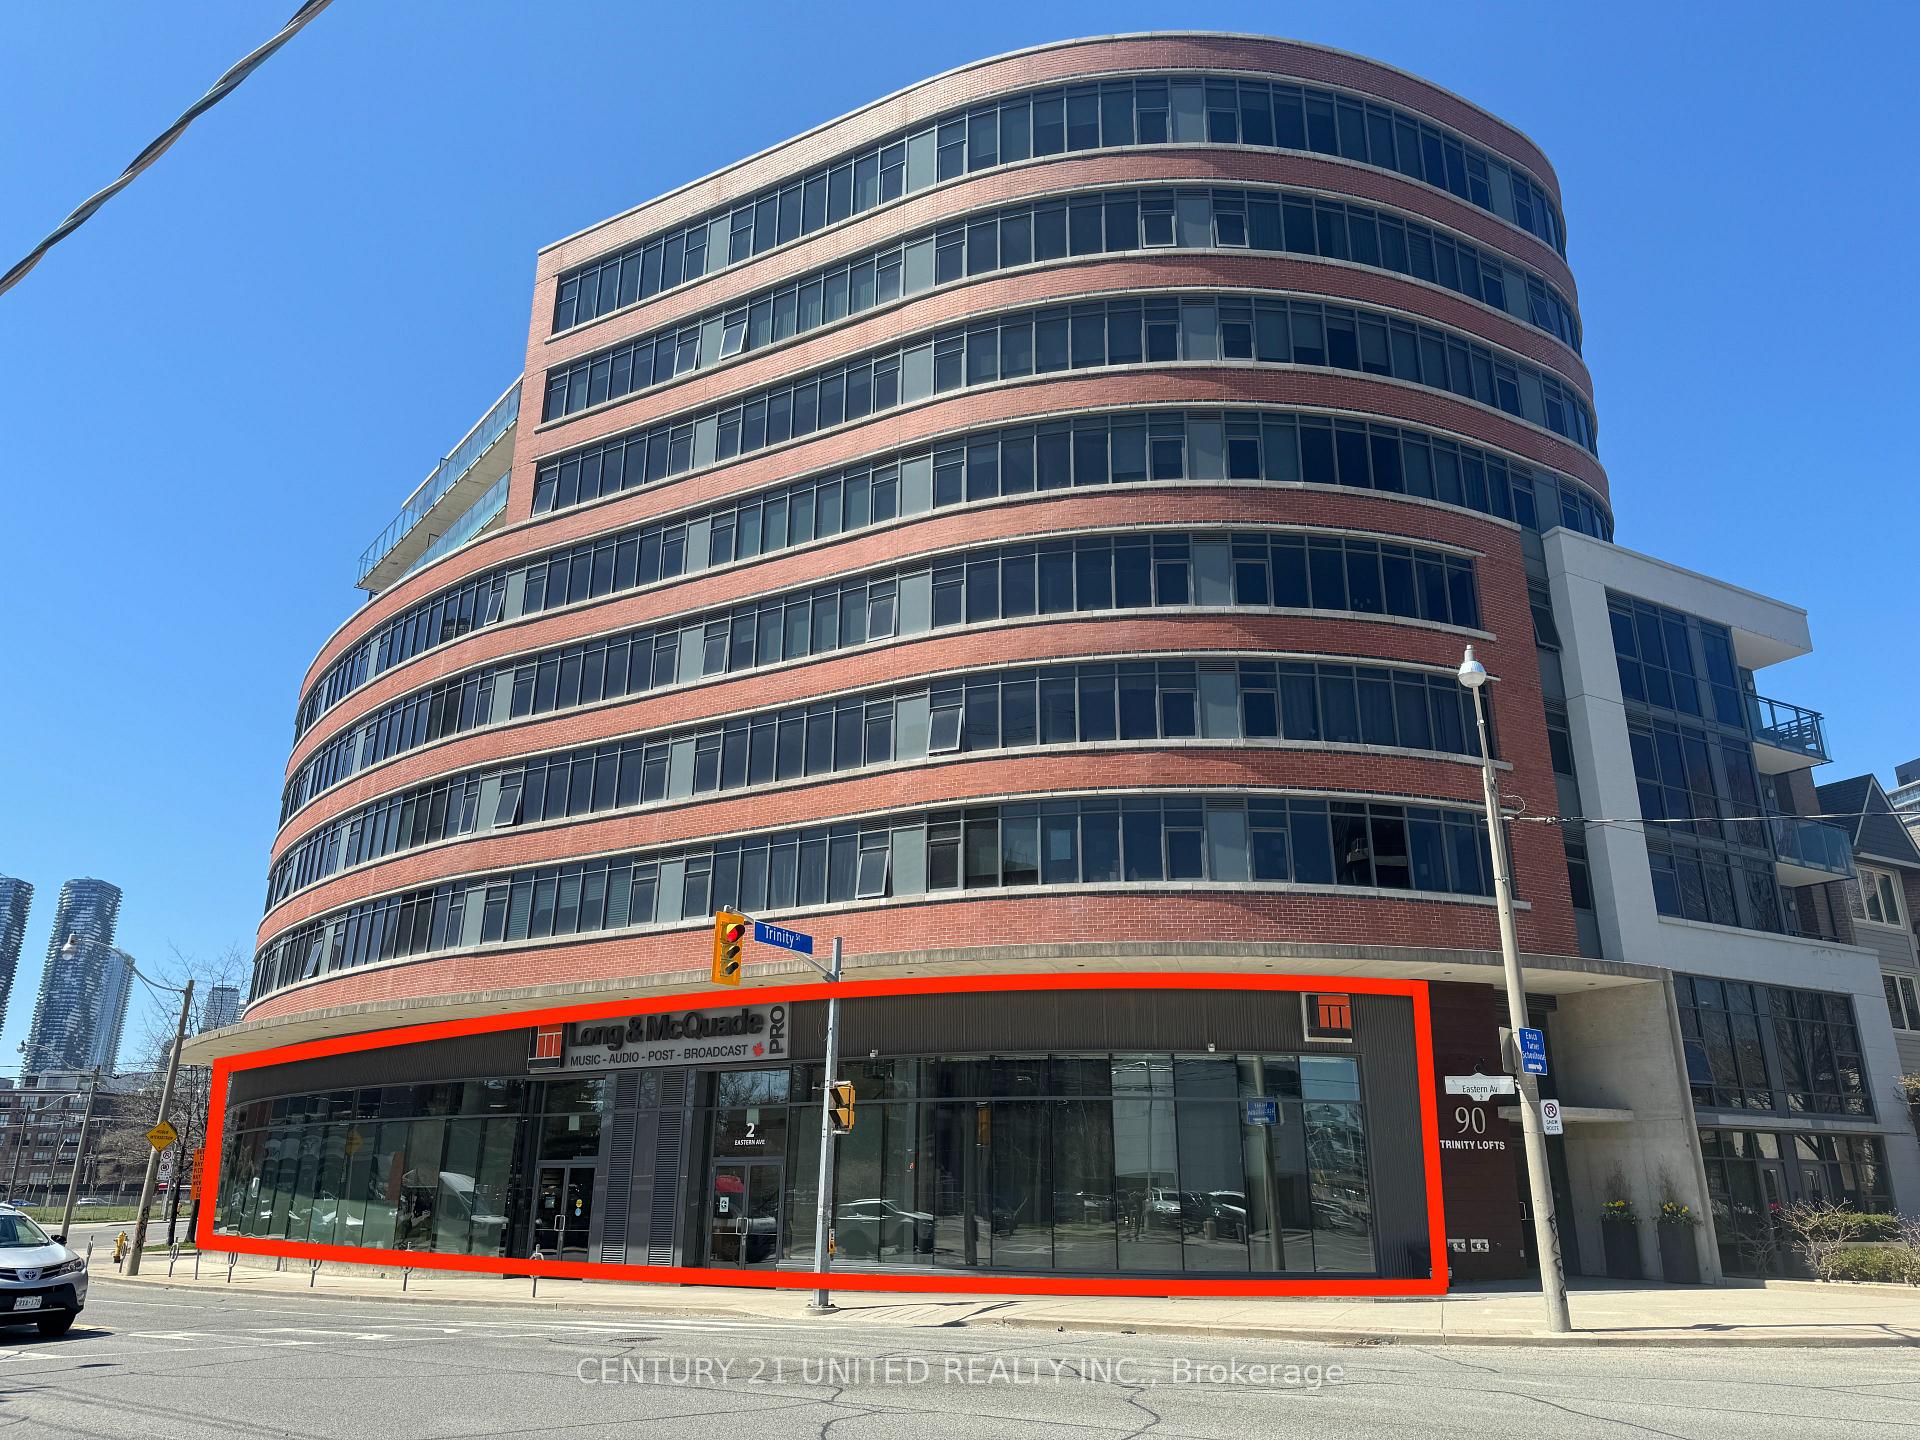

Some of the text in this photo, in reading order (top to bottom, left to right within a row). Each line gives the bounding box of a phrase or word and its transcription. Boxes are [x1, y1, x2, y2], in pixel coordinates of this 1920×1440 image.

[764, 925, 795, 949] Trinity
[568, 1008, 765, 1051] Long & McQuade
[768, 1005, 786, 1055] PRO
[570, 1054, 601, 1067] MUSIC
[608, 1051, 639, 1064] AUDIO
[648, 1049, 675, 1062] POST
[683, 1044, 748, 1060] BROADCAST
[1462, 1084, 1498, 1093] Eastern Av
[745, 1122, 755, 1138] 2
[1455, 1106, 1486, 1134] 90
[1440, 1139, 1506, 1151] TRINITY LOFTS
